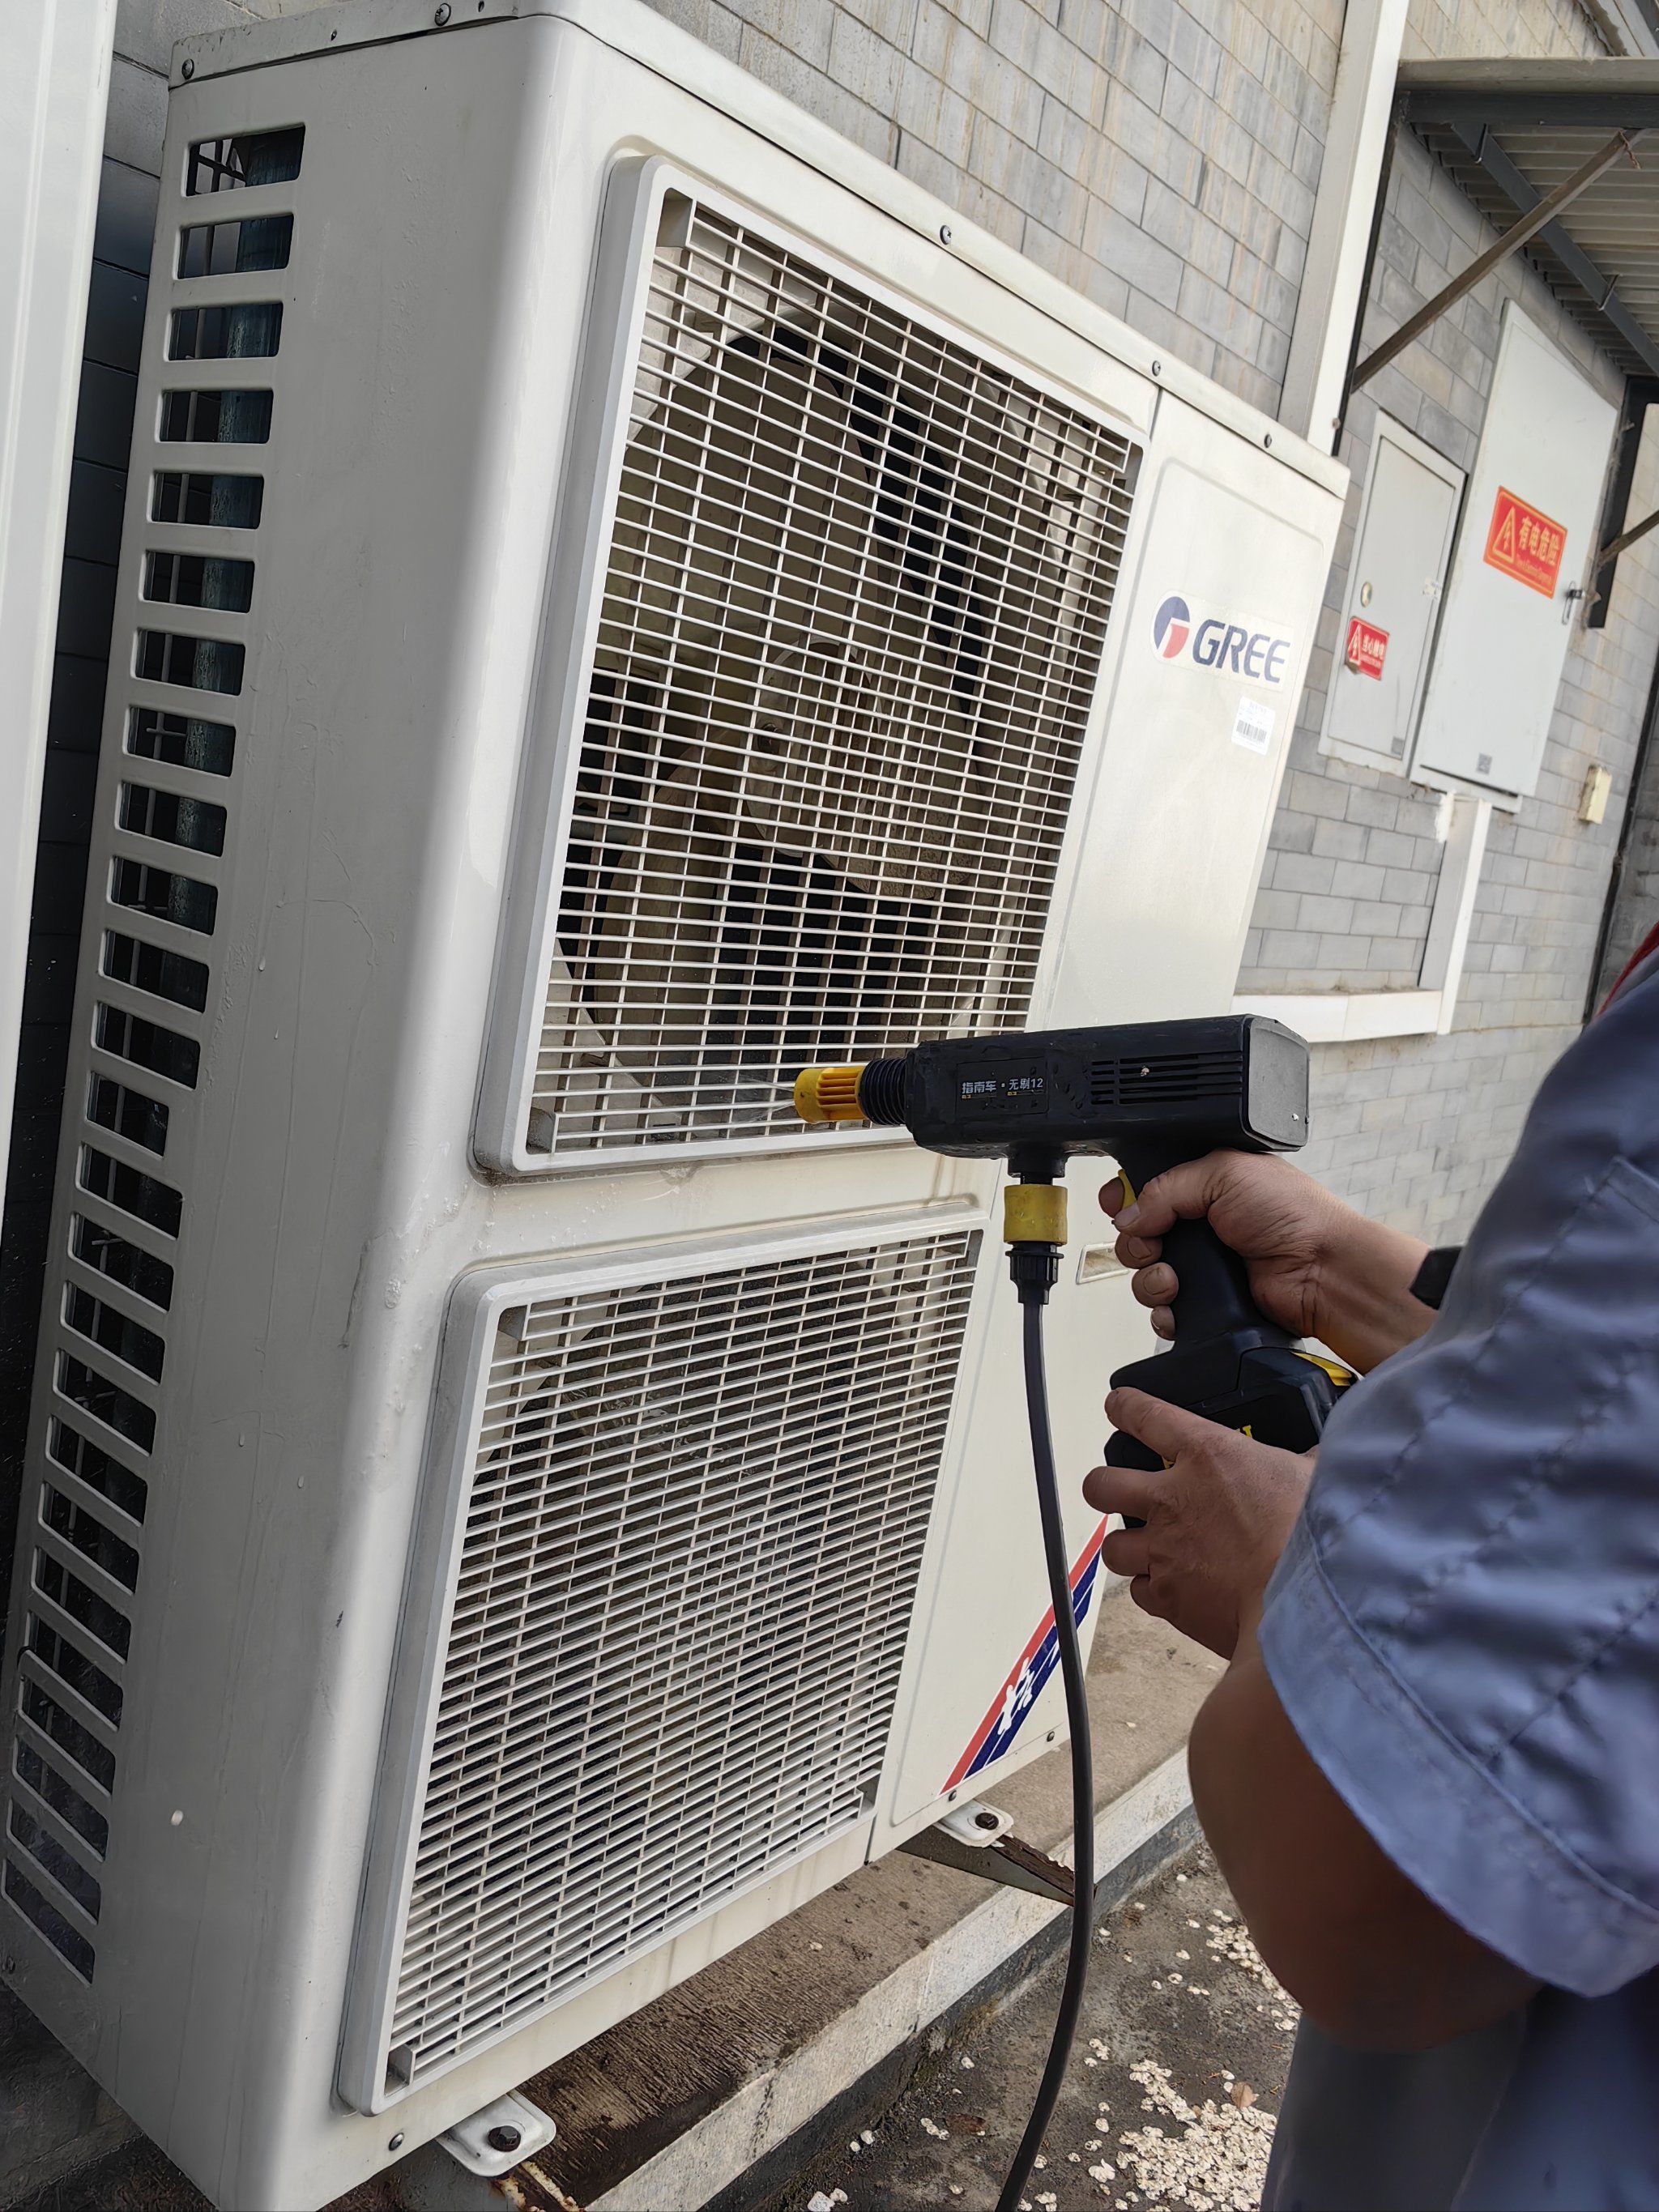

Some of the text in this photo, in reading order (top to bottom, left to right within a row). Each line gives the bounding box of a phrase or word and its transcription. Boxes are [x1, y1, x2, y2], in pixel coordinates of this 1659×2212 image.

[1518, 515, 1560, 567] 有电危险
[1192, 618, 1291, 684] GREE
